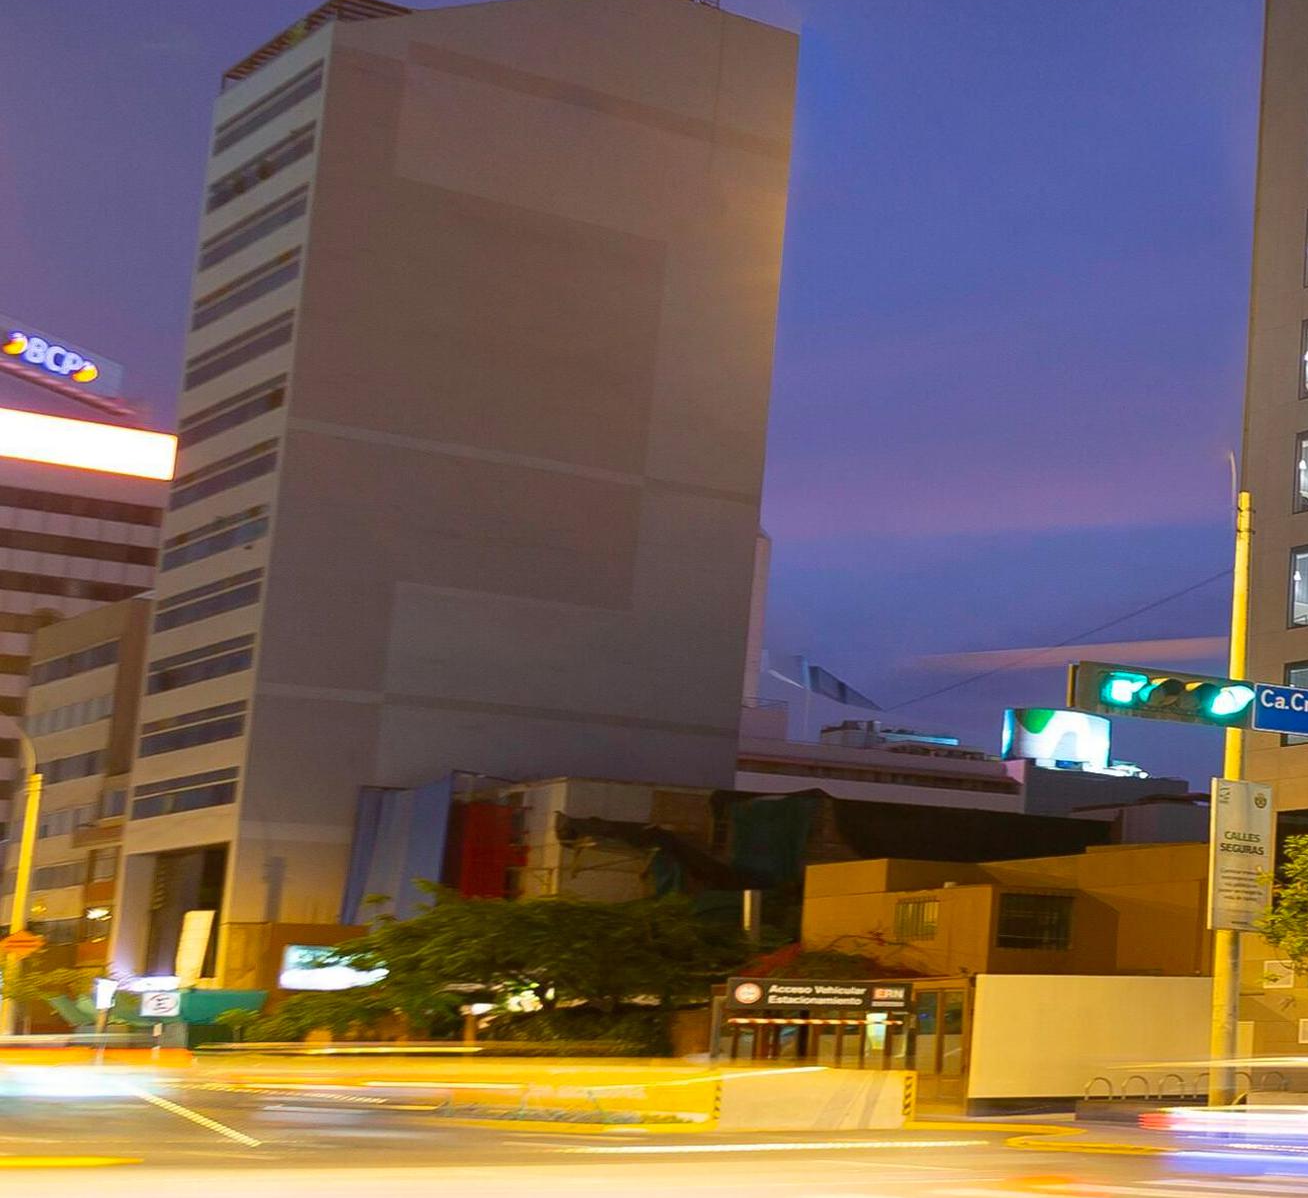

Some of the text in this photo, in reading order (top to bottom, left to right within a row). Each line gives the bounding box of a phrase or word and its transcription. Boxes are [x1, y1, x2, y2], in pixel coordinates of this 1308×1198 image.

[25, 337, 84, 375] BCP
[1260, 689, 1289, 710] Ca.
[1224, 830, 1261, 843] CALLES
[1219, 842, 1265, 856] SEGURAS
[768, 984, 867, 996] Acceso Vehicular
[767, 995, 864, 1006] Estacionamiento
